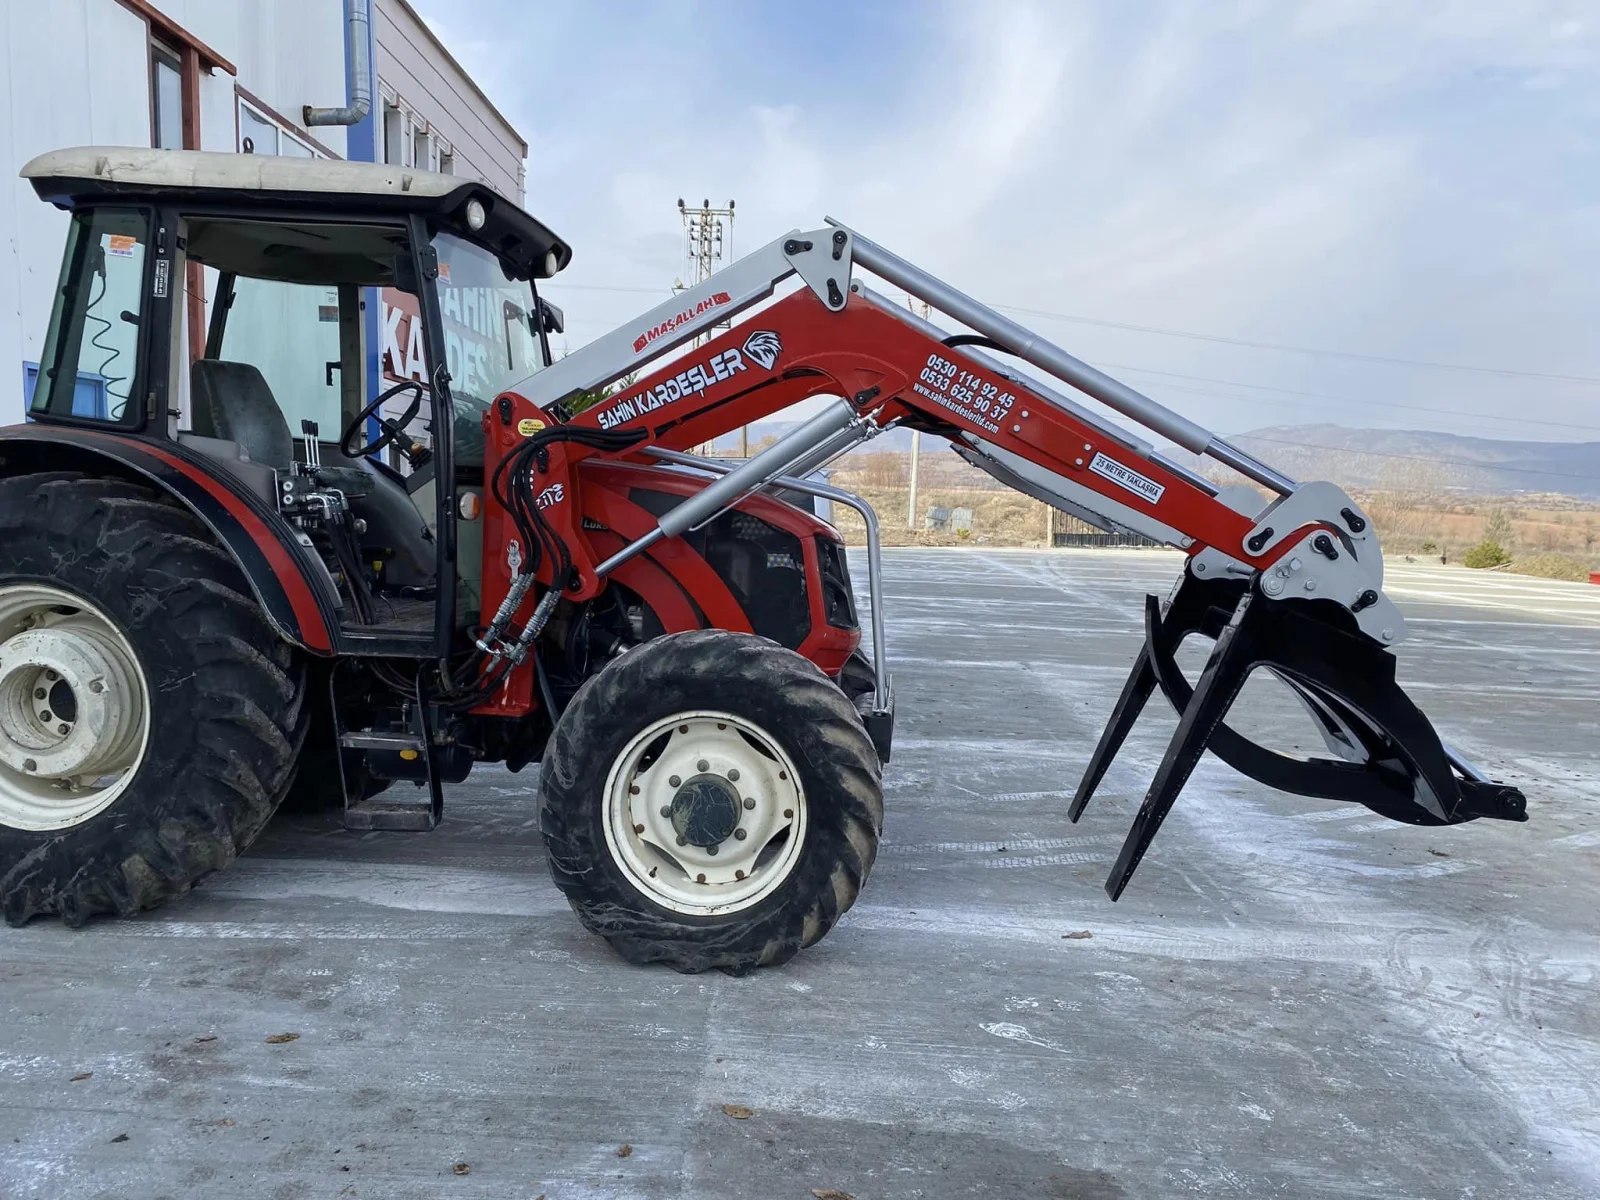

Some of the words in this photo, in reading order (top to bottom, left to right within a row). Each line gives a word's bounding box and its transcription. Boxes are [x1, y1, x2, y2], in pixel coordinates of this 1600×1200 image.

[439, 287, 502, 343] AHİN
[647, 298, 713, 341] MAŞALLAH
[634, 347, 747, 414] KARDEŞLER
[920, 367, 950, 391] 0533
[950, 384, 974, 404] 625
[973, 396, 990, 412] 90
[990, 405, 1008, 421] 37
[927, 354, 957, 377] 0530
[959, 370, 982, 390] 114
[981, 382, 998, 400] 92
[998, 392, 1016, 408] 45
[913, 382, 999, 434] www.sahinkardeslerltd.com
[1096, 458, 1105, 468] 25
[1105, 463, 1127, 479] METRE
[1126, 475, 1159, 497] YAKLAŞMA
